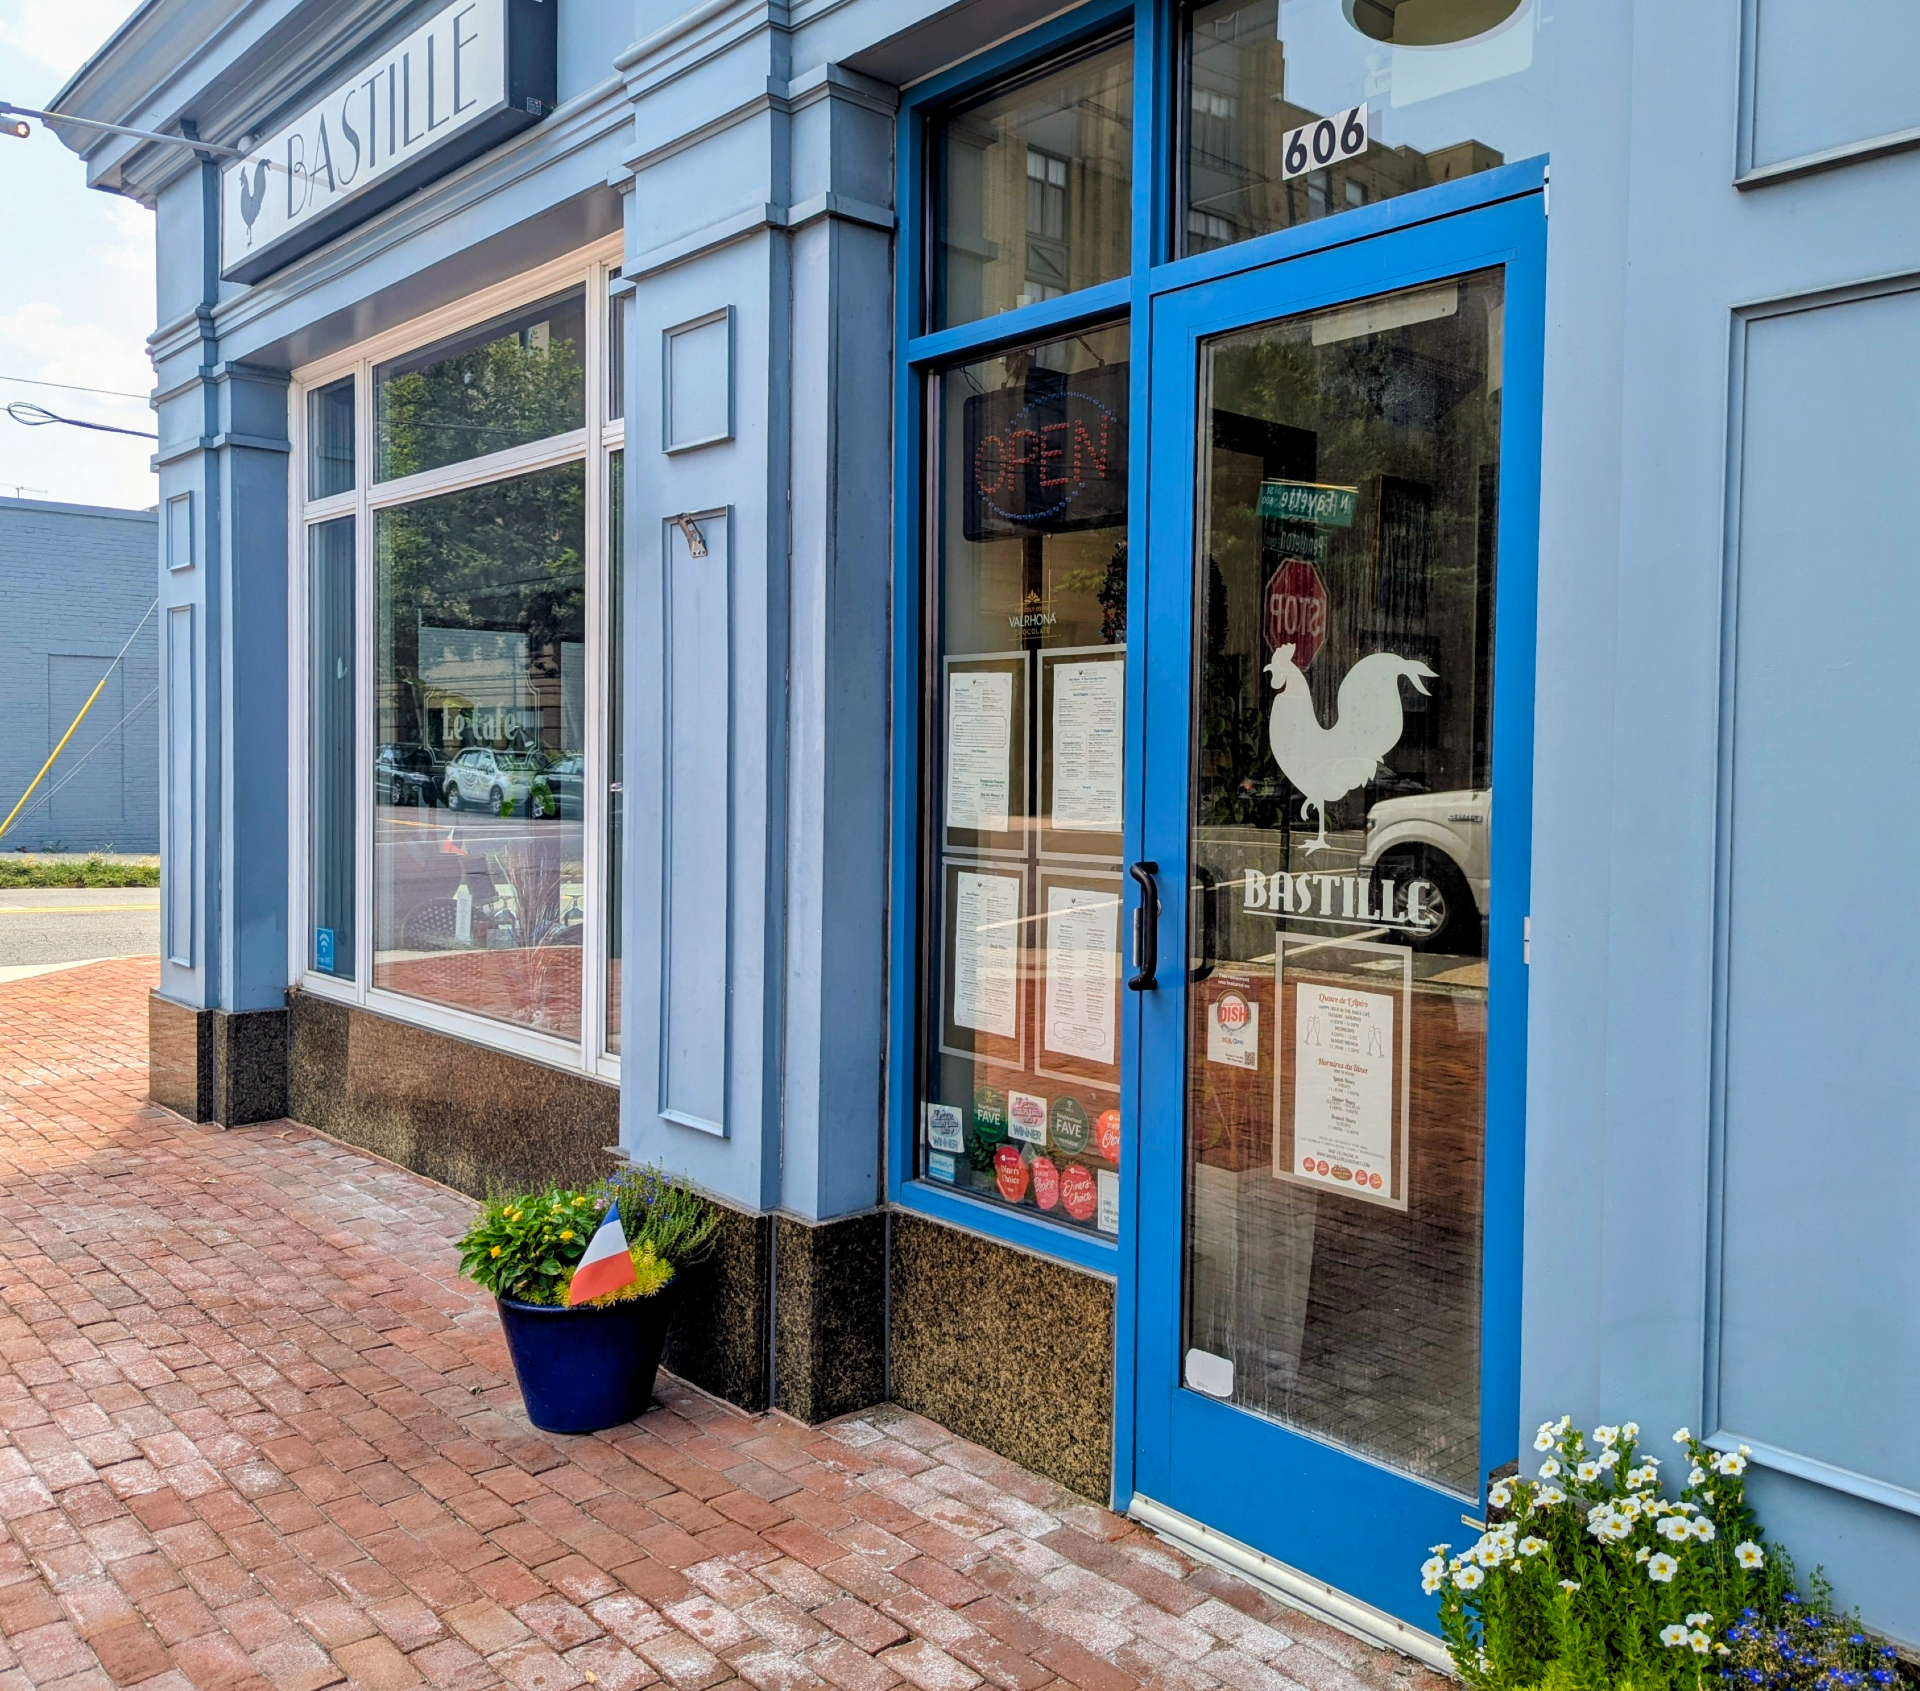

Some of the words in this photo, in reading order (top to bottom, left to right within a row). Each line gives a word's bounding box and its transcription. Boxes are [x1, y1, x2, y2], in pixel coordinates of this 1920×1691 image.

[287, 2, 478, 220] BASTILLE
[1285, 107, 1364, 174] 606
[975, 414, 1109, 494] OPEN
[1009, 612, 1056, 628] VALRHONA
[442, 699, 465, 741] Le
[1243, 868, 1431, 926] BASTILLE
[1227, 974, 1250, 983] restaurant
[1227, 980, 1244, 988] featured
[1219, 1006, 1248, 1023] DISH
[1318, 1058, 1344, 1069] Horaires
[1345, 1063, 1352, 1071] du
[977, 1109, 1001, 1126] FAVE
[1056, 1112, 1082, 1124] Neighborhood
[1013, 1124, 1042, 1142] WINNER
[1056, 1119, 1082, 1138] FAVE
[932, 1136, 958, 1149] WINNER
[1001, 1173, 1020, 1185] Choice
[1034, 1176, 1055, 1192] Choice
[1062, 1177, 1092, 1197] Diners'
[1069, 1190, 1092, 1206] Choice
[1103, 1199, 1112, 1208] pay
